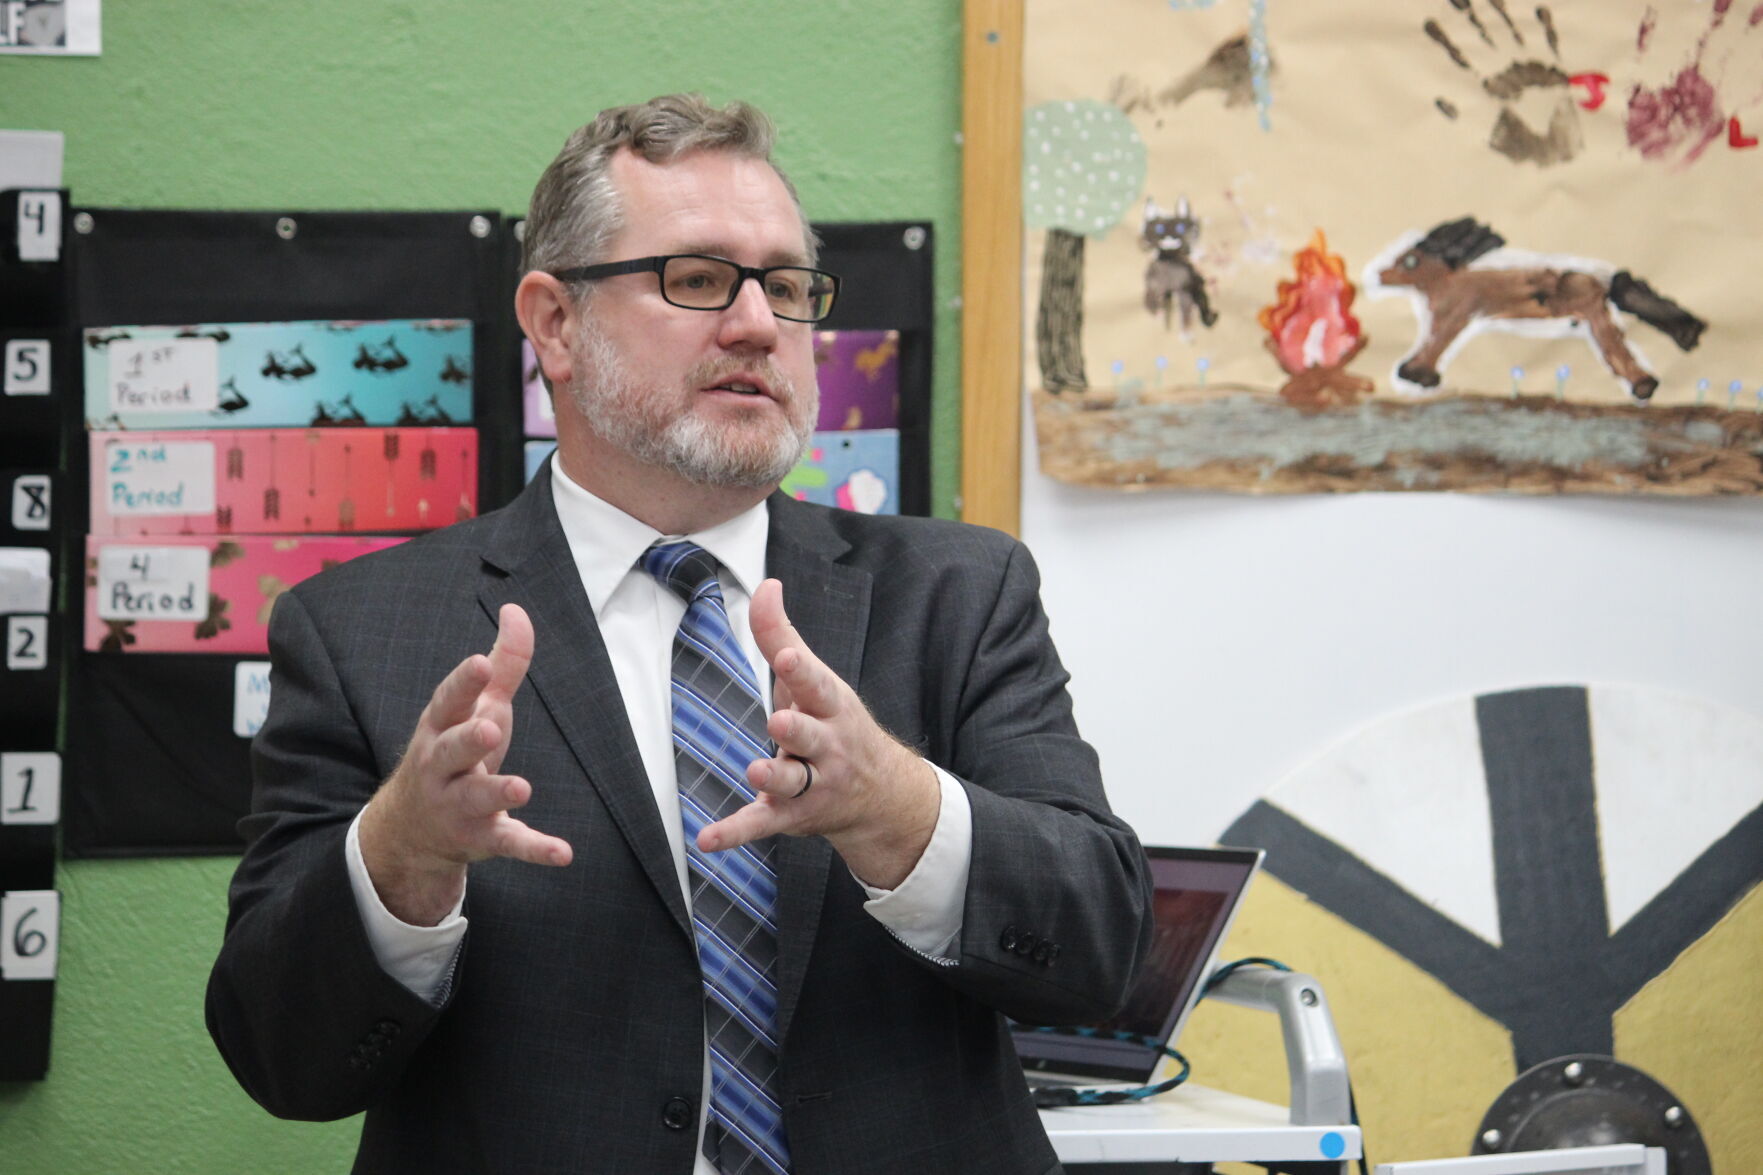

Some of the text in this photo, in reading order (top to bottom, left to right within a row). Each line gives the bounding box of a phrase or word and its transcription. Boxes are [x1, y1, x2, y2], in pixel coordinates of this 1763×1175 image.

[1728, 115, 1759, 147] L
[24, 201, 44, 235] 4
[13, 347, 38, 381] 5
[117, 381, 191, 404] Period
[110, 445, 167, 472] 2nd
[112, 481, 185, 508] Period
[130, 554, 150, 580] 4
[111, 581, 194, 611] Period
[15, 626, 37, 658] 2
[7, 767, 37, 814] 1
[14, 907, 46, 957] 6
